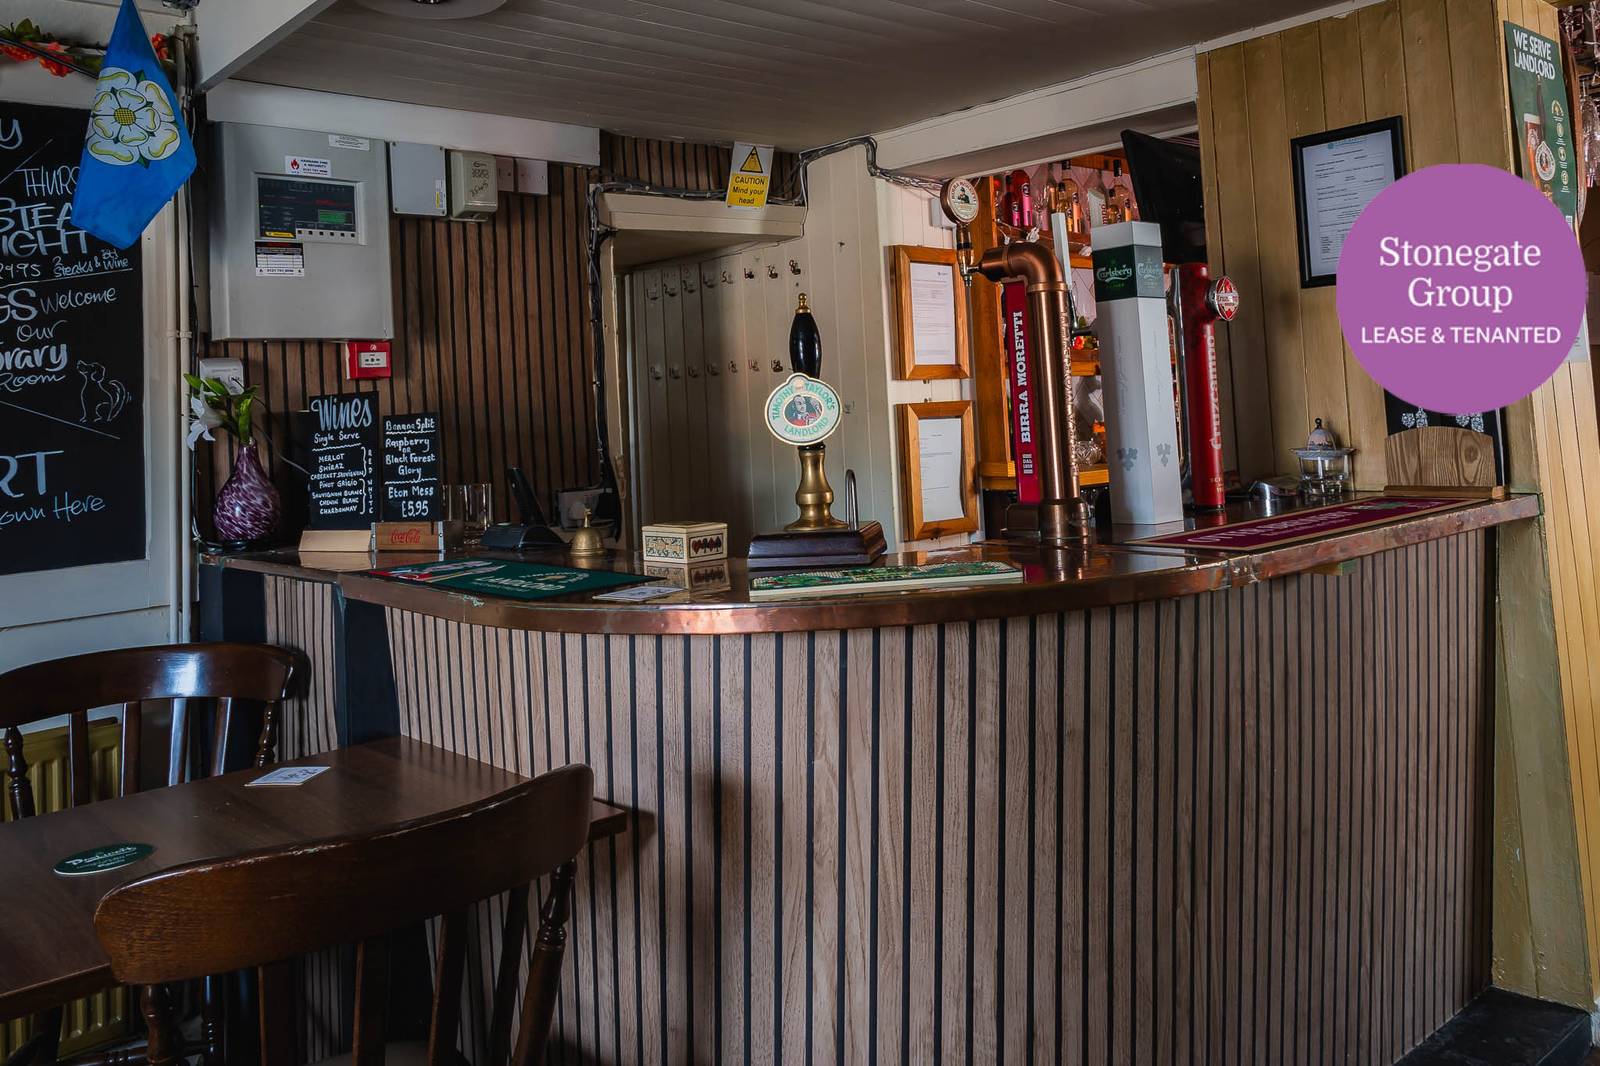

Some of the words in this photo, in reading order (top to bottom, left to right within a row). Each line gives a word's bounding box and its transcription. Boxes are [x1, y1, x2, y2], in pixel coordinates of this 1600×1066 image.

[1513, 29, 1528, 51] WE
[1529, 36, 1552, 61] SERVE
[1513, 49, 1556, 80] LANDLORD
[735, 176, 765, 186] CAUTION
[733, 186, 748, 194] Mind
[749, 189, 765, 197] your
[1097, 264, 1133, 283] Carlsberg
[40, 287, 118, 315] Welcome
[1013, 311, 1027, 387] MORETTI
[772, 384, 794, 421] TIMOTHY
[311, 395, 372, 431] Wines
[1019, 390, 1031, 443] BIRRA
[416, 417, 436, 432] Split
[784, 416, 829, 437] LANDLORD
[314, 432, 335, 447] Single
[339, 430, 361, 441] Serve
[385, 436, 430, 453] Raspberry
[318, 453, 345, 463] MERLOT
[385, 453, 409, 465] Black
[410, 452, 436, 463] Forest
[398, 464, 422, 482] Glory
[388, 486, 409, 499] Eton
[411, 485, 434, 497] Mess
[52, 491, 106, 523] Here
[401, 500, 429, 518] £5.95
